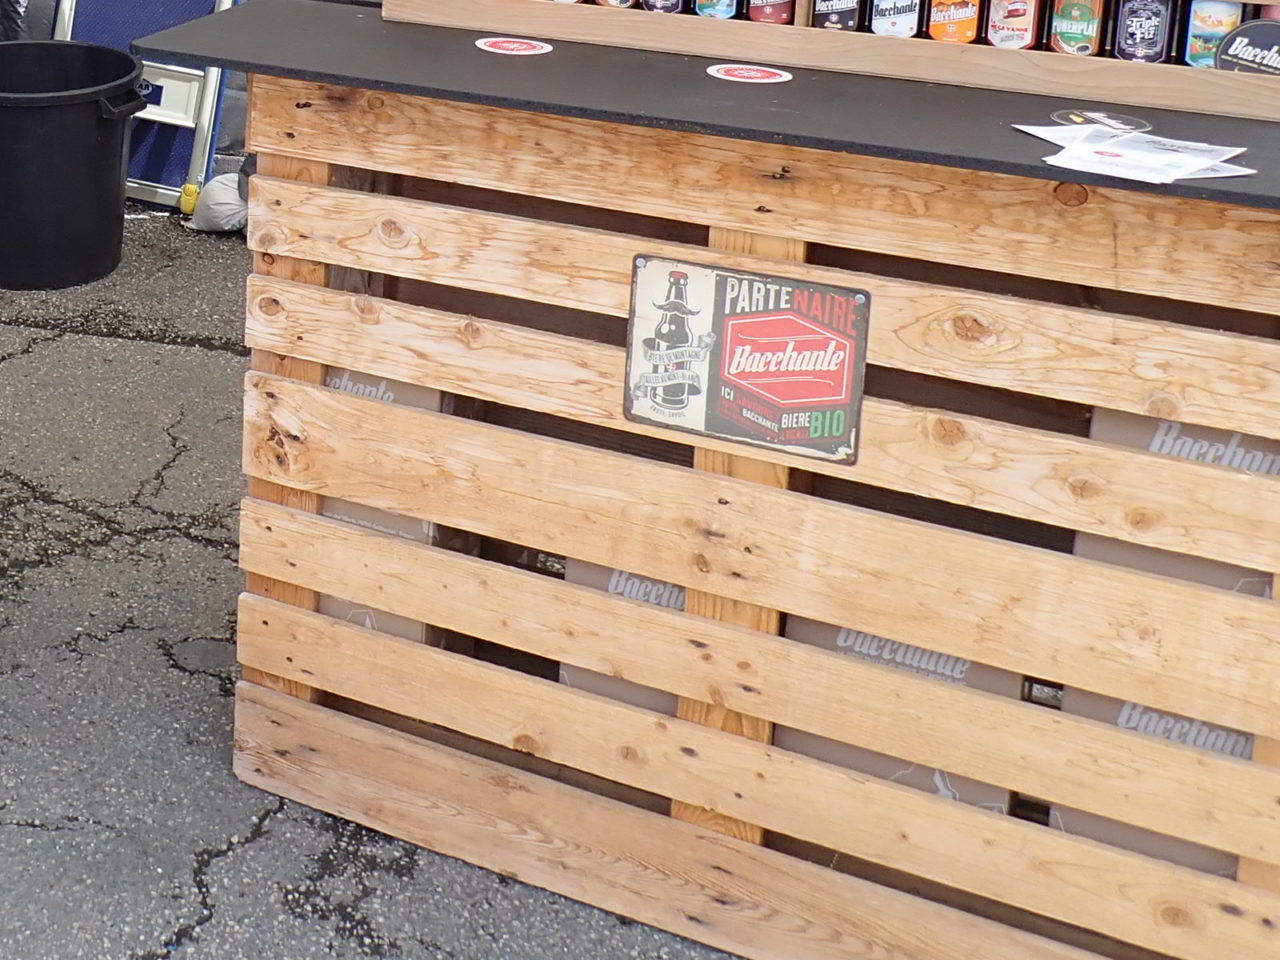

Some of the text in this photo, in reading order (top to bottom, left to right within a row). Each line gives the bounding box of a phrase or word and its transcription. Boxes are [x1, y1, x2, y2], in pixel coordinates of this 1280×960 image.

[931, 2, 977, 22] Bacchante
[724, 277, 857, 337] PARTENAIRE
[729, 340, 845, 375] Bacchante
[721, 386, 734, 401] ICI
[742, 408, 779, 433] BACCHANTE
[781, 412, 811, 428] BIERE
[810, 410, 845, 438] BIO
